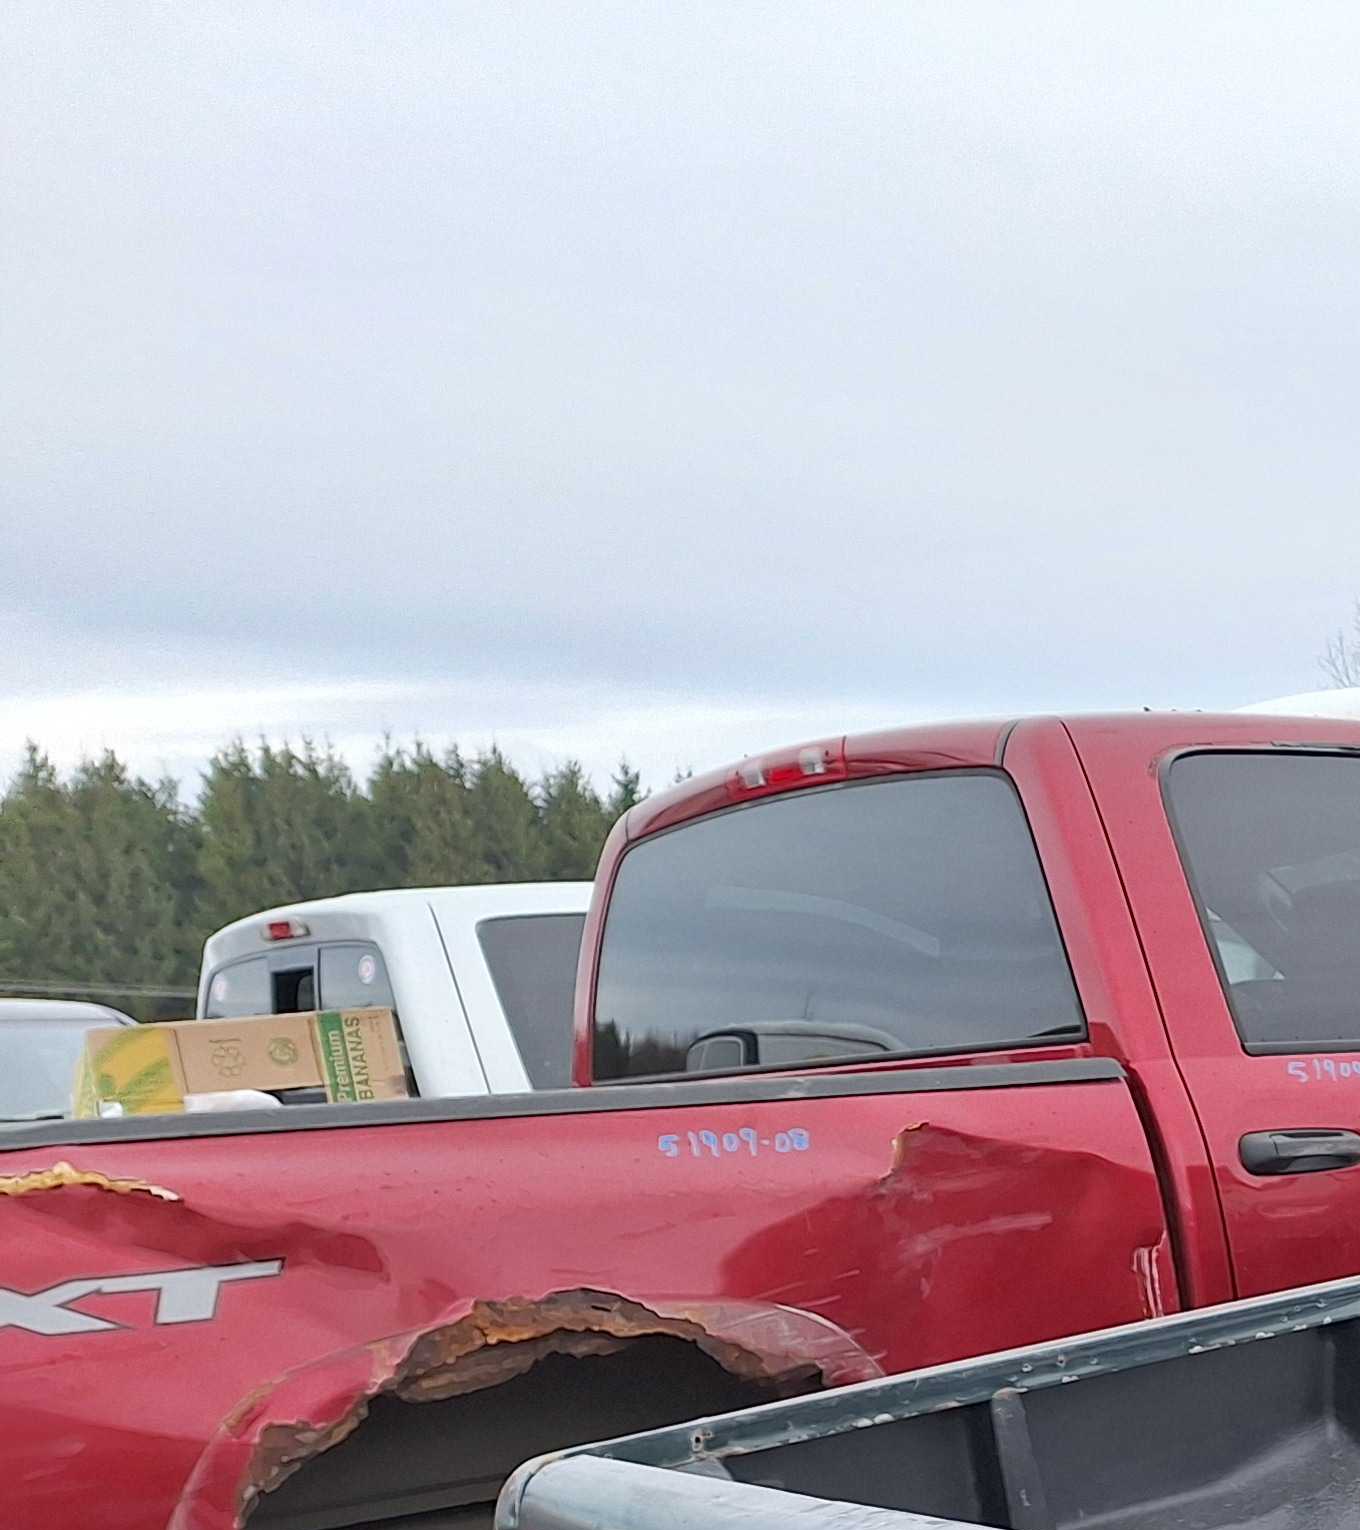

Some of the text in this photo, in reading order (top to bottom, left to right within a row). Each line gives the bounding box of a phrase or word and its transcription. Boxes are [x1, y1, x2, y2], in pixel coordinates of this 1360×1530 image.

[328, 1029, 352, 1103] Premium
[344, 1016, 375, 1100] BANANAS
[657, 1127, 810, 1158] 51909-08
